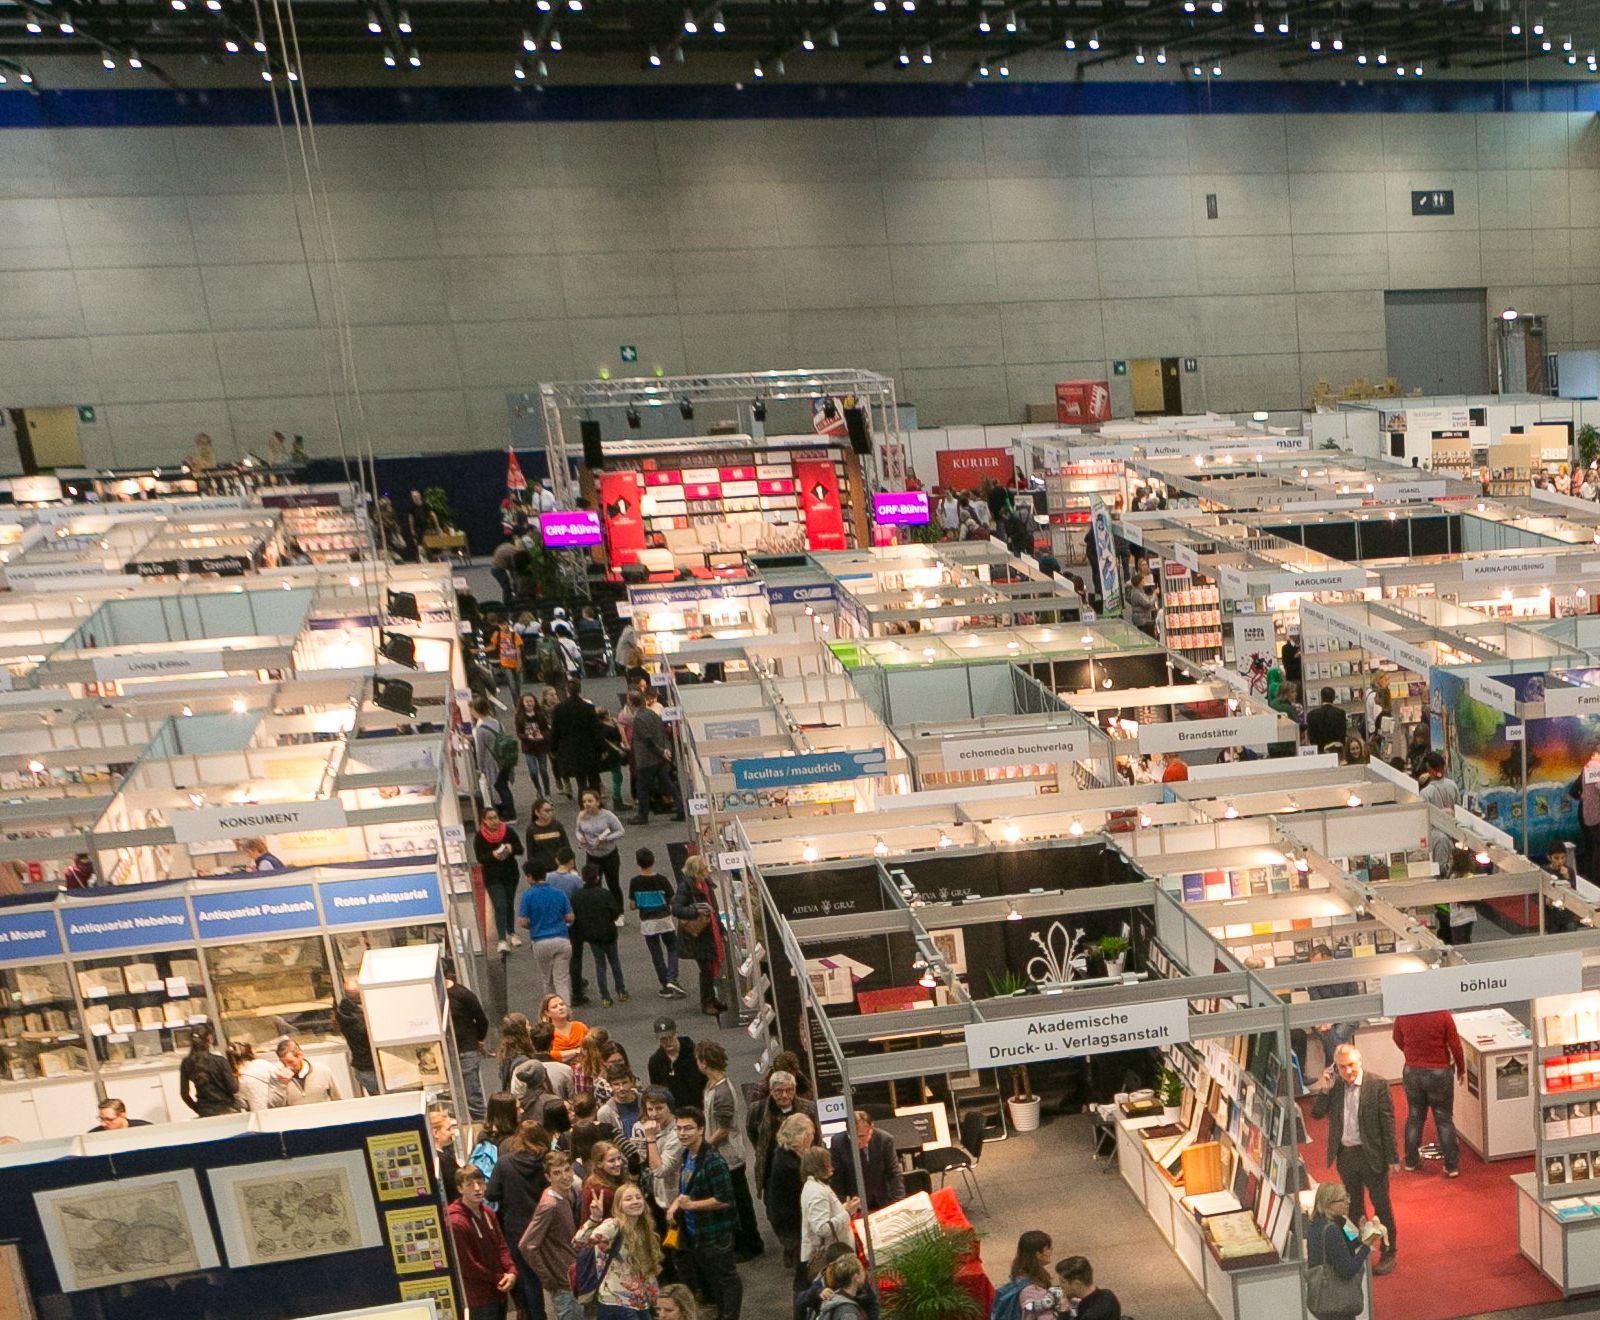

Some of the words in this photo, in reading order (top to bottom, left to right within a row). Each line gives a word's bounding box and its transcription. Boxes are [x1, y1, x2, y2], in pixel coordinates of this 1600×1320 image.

[1277, 439, 1302, 448] mare
[952, 456, 1000, 470] KURIER
[879, 504, 929, 515] ORF-Bühne
[545, 523, 600, 537] ORF-Bühne
[1474, 562, 1545, 574] KARINA-PUBLISHING
[1295, 575, 1342, 586] KAROLINGER
[128, 661, 156, 672] Living
[1178, 729, 1239, 742] Brandstätter
[959, 745, 1015, 760] echomedia
[1018, 741, 1074, 757] buchverlag
[743, 766, 785, 780] facultas
[791, 761, 842, 777] maudrich
[219, 813, 299, 829] KONSUMENT
[368, 888, 428, 906] Antiquariat
[200, 906, 261, 923] Antiquariat
[262, 900, 314, 916] Paulusch
[70, 918, 133, 935] Antiquariat
[135, 913, 185, 930] Nebehay
[10, 927, 47, 942] Moser
[1460, 975, 1507, 993] böhlau
[1027, 1012, 1129, 1036] Akademische
[989, 1040, 1041, 1059] Druck-
[1044, 1041, 1059, 1053] u.
[1063, 1025, 1169, 1053] Verlagsanstalt
[825, 1103, 845, 1113] C01
